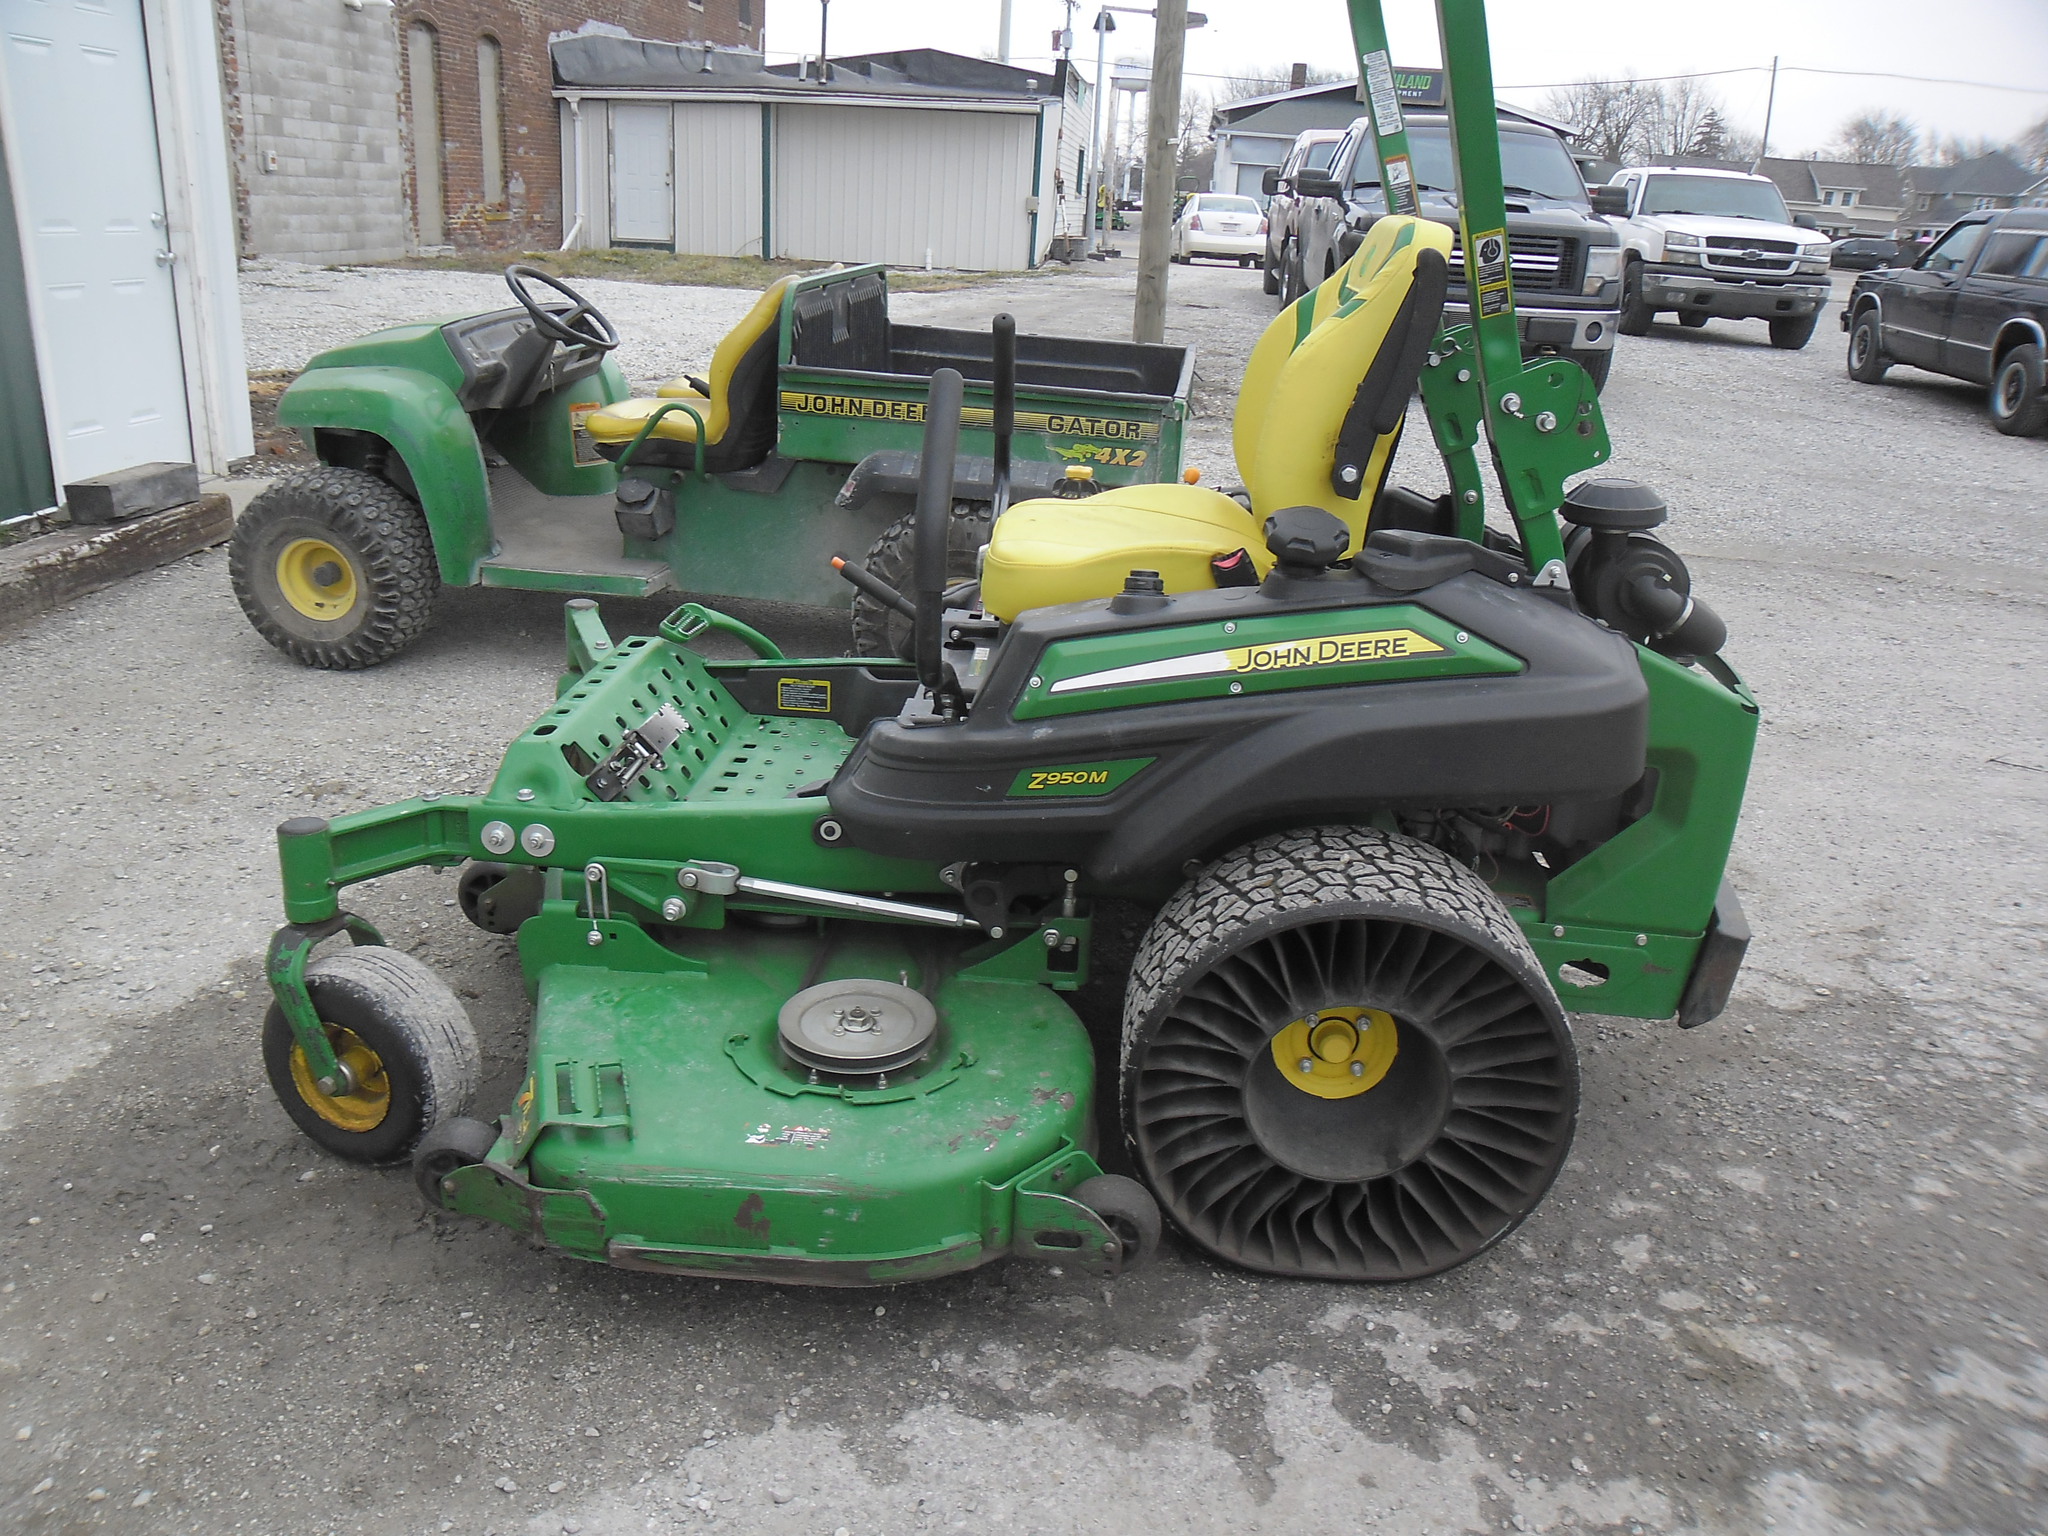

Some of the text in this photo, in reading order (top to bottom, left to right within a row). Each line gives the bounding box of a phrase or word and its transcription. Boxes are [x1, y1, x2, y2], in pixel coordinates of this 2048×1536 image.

[797, 395, 863, 415] JOHN
[1047, 415, 1141, 439] GATOR
[1094, 447, 1148, 467] 4X2
[1237, 637, 1409, 670] JOHN DEERE
[1027, 771, 1109, 789] Z950M
